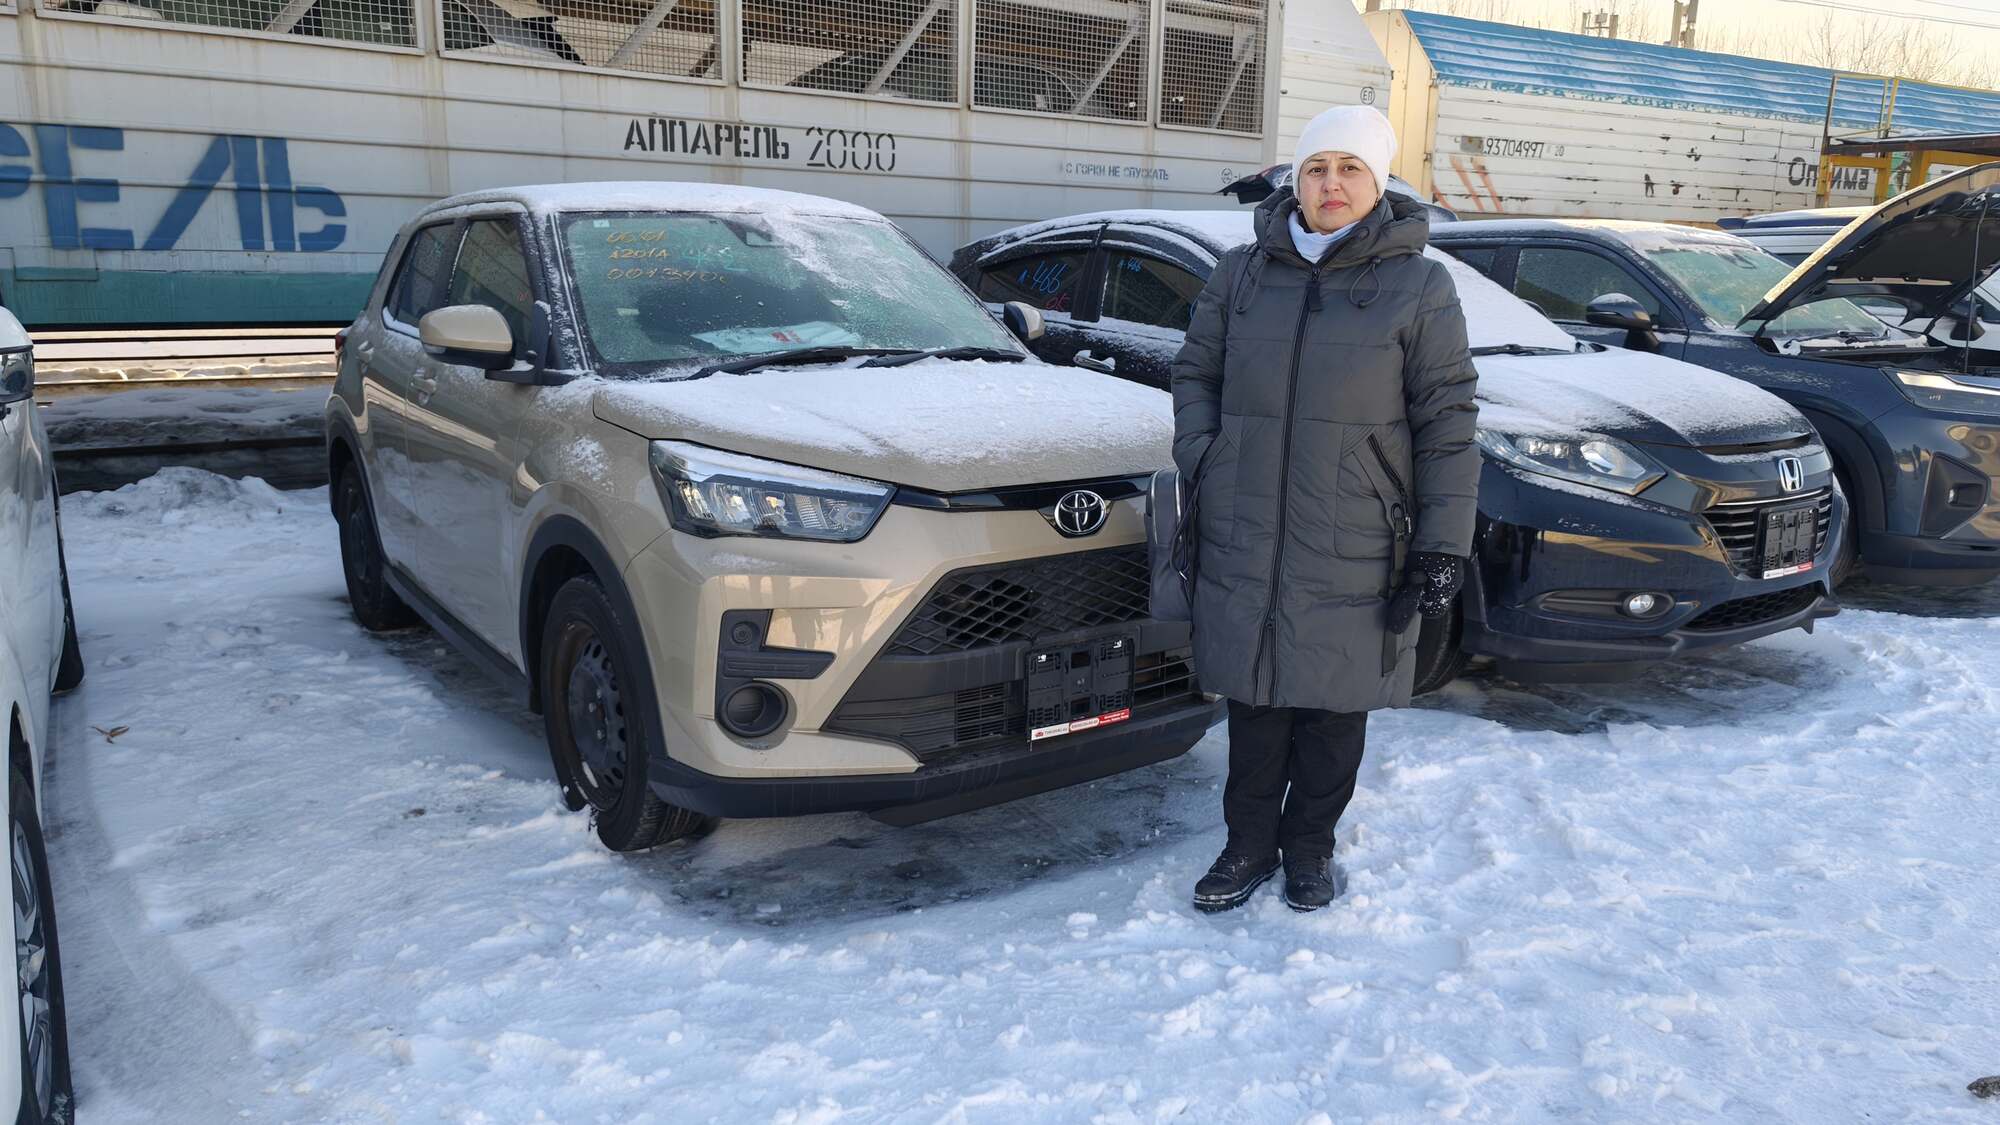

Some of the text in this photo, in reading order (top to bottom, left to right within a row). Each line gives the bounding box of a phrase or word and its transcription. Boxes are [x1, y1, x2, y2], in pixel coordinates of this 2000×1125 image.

[624, 118, 896, 171] АППАРЕЛЬ 2000
[1108, 165, 1121, 178] НЕ
